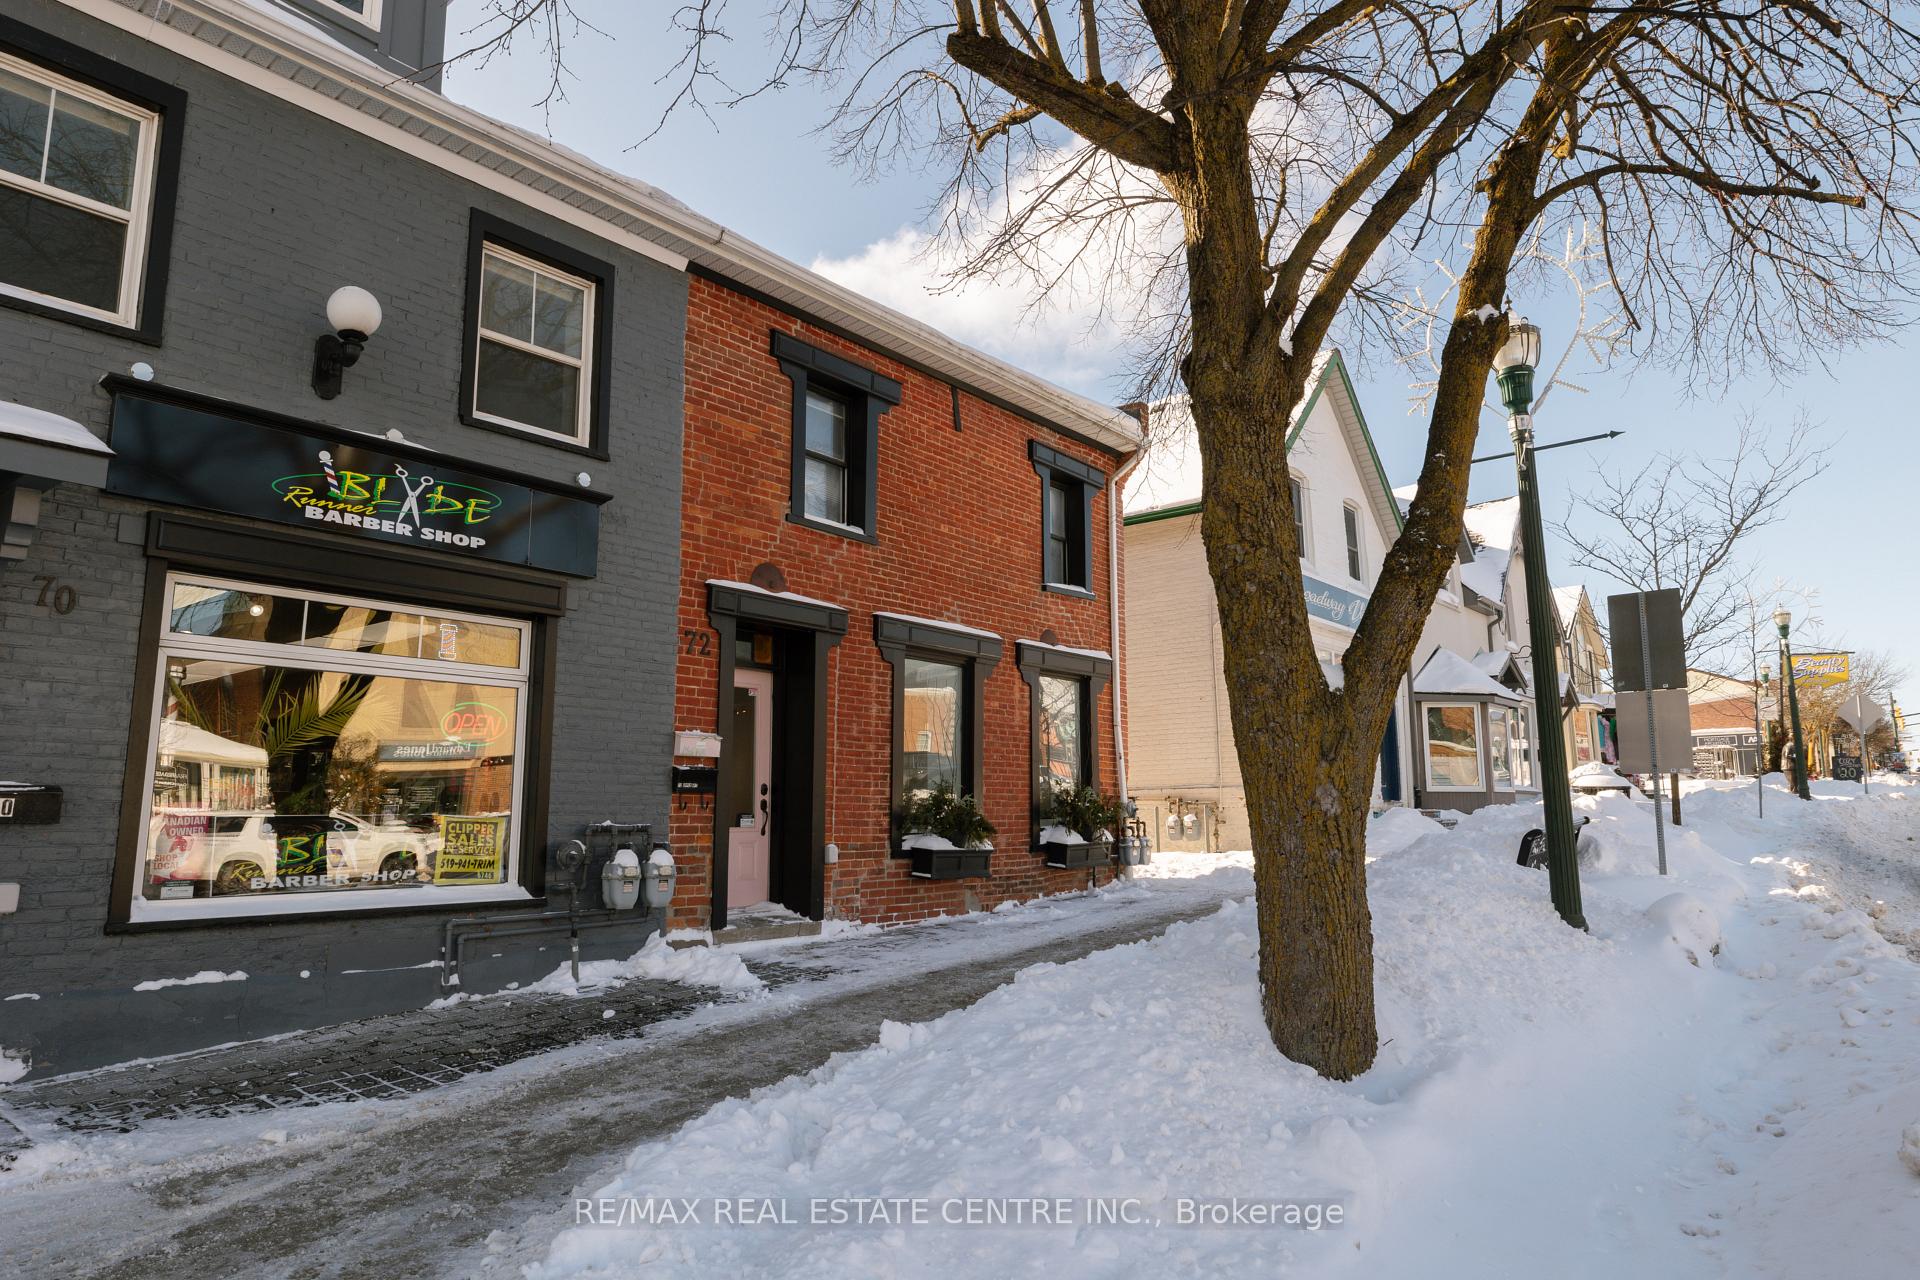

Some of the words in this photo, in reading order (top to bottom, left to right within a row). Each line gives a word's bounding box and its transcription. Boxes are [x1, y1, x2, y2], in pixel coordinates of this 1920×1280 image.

[283, 486, 377, 516] Runner
[304, 505, 413, 537] BARBER
[420, 527, 487, 549] SHOP
[32, 575, 76, 616] 70
[1304, 590, 1345, 621] oadway
[684, 630, 712, 657] 72
[1794, 657, 1846, 671] Beauty
[1793, 667, 1846, 680] Supplies
[444, 712, 500, 738] OPEN
[163, 816, 207, 826] ANADIAN
[169, 826, 204, 837] OWNED
[448, 823, 495, 835] CLIPPER
[447, 833, 495, 847] SALES
[458, 846, 495, 854] SERVICE
[154, 854, 178, 863] SHOP
[250, 873, 350, 890] BARBER
[361, 869, 416, 882] SHOP
